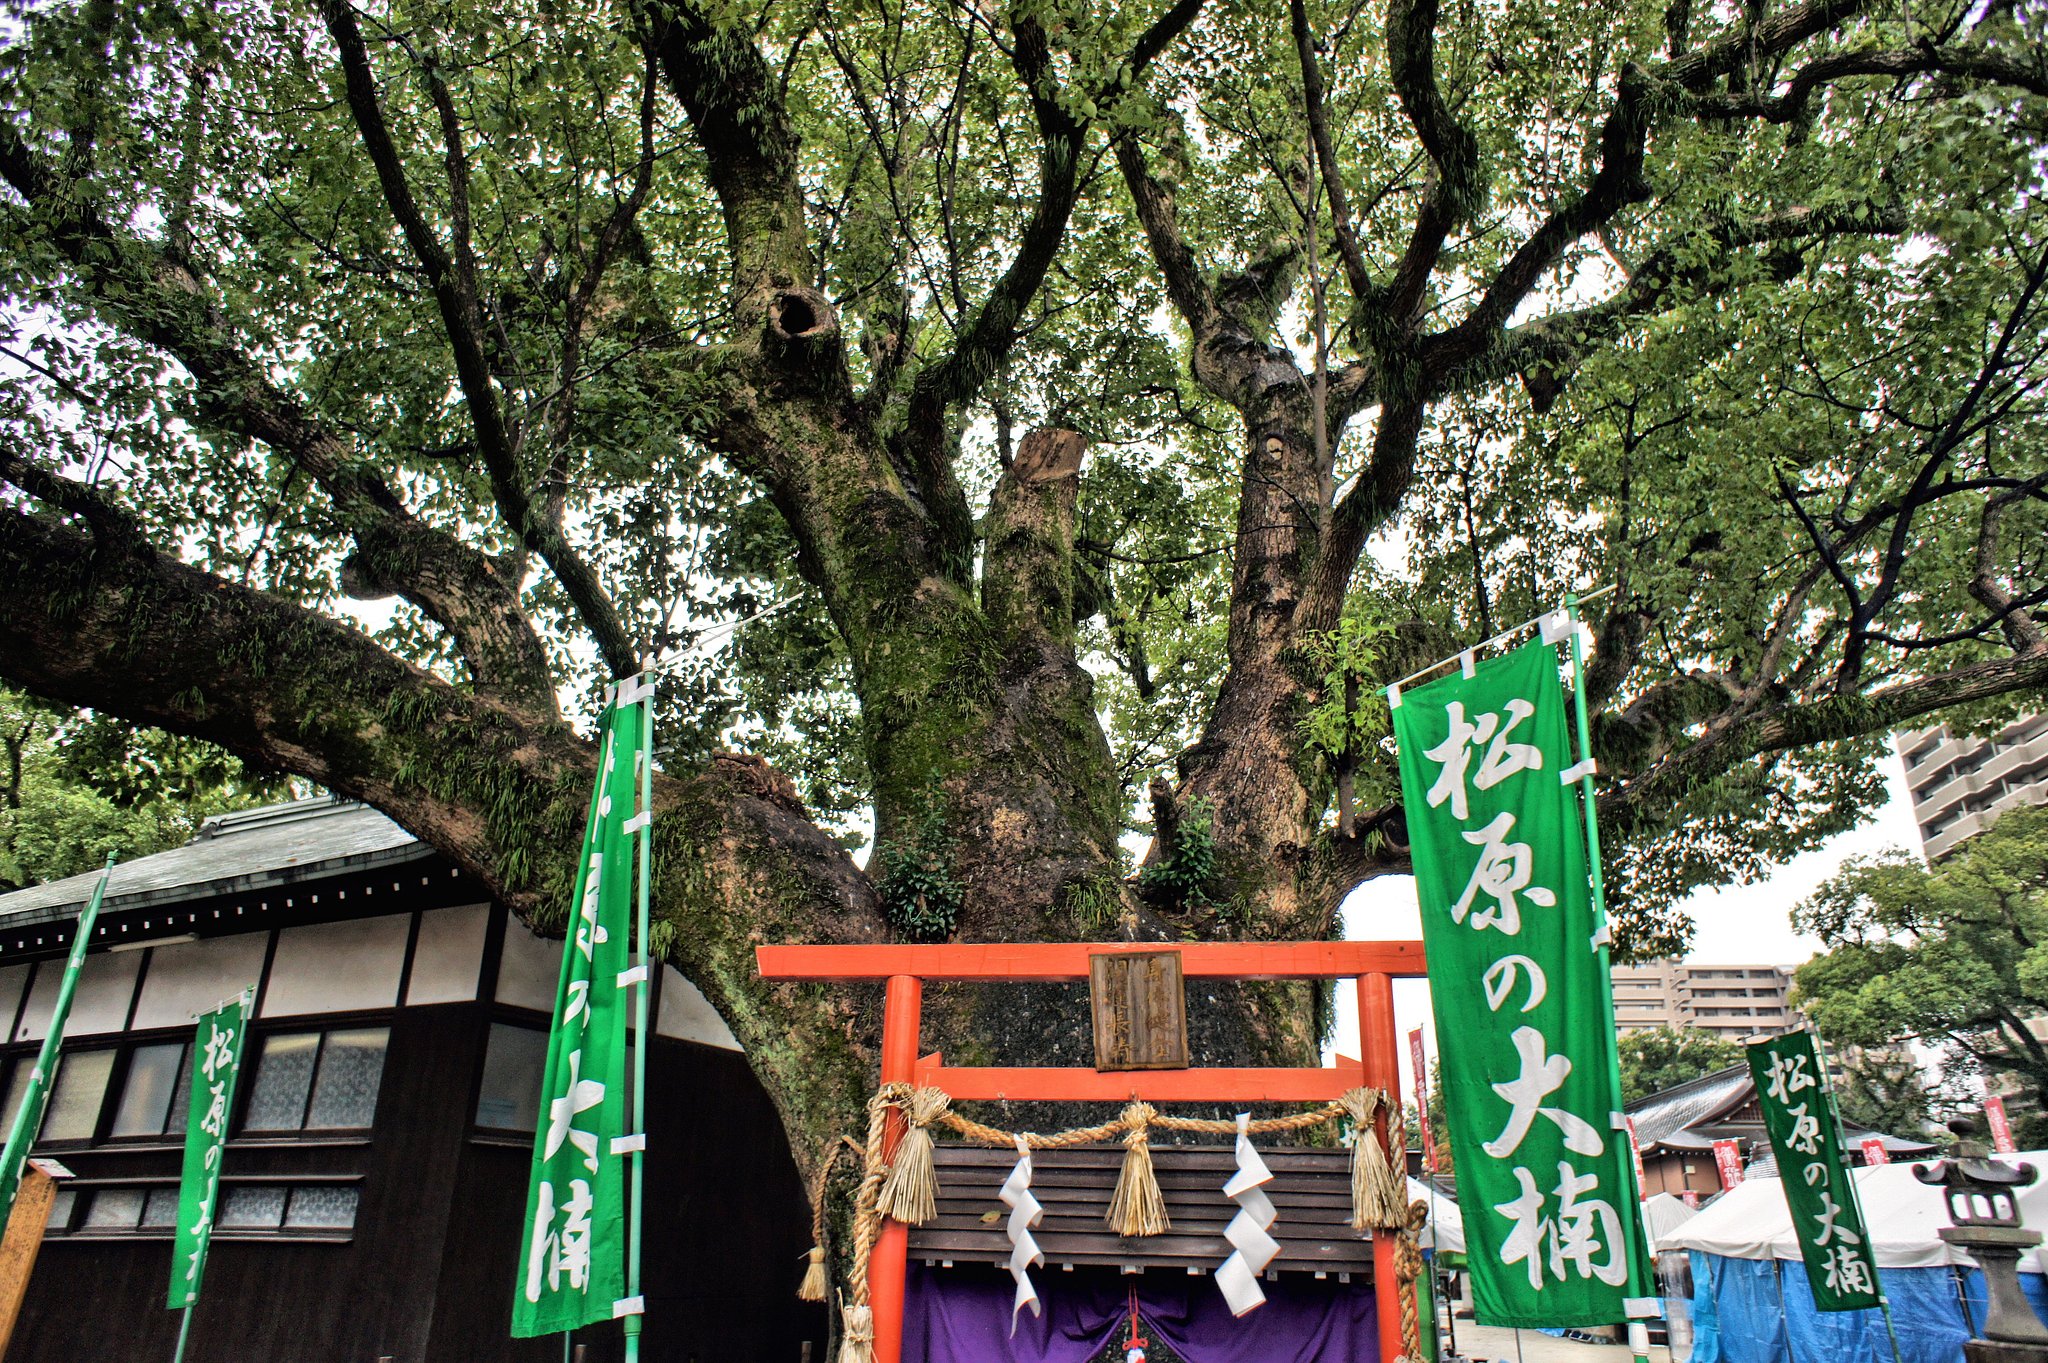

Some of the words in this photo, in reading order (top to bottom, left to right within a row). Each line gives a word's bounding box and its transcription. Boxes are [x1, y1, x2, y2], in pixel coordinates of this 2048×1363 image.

[1422, 698, 1628, 1292] 松原の大楠
[1763, 1050, 1875, 1298] 松原の大楠
